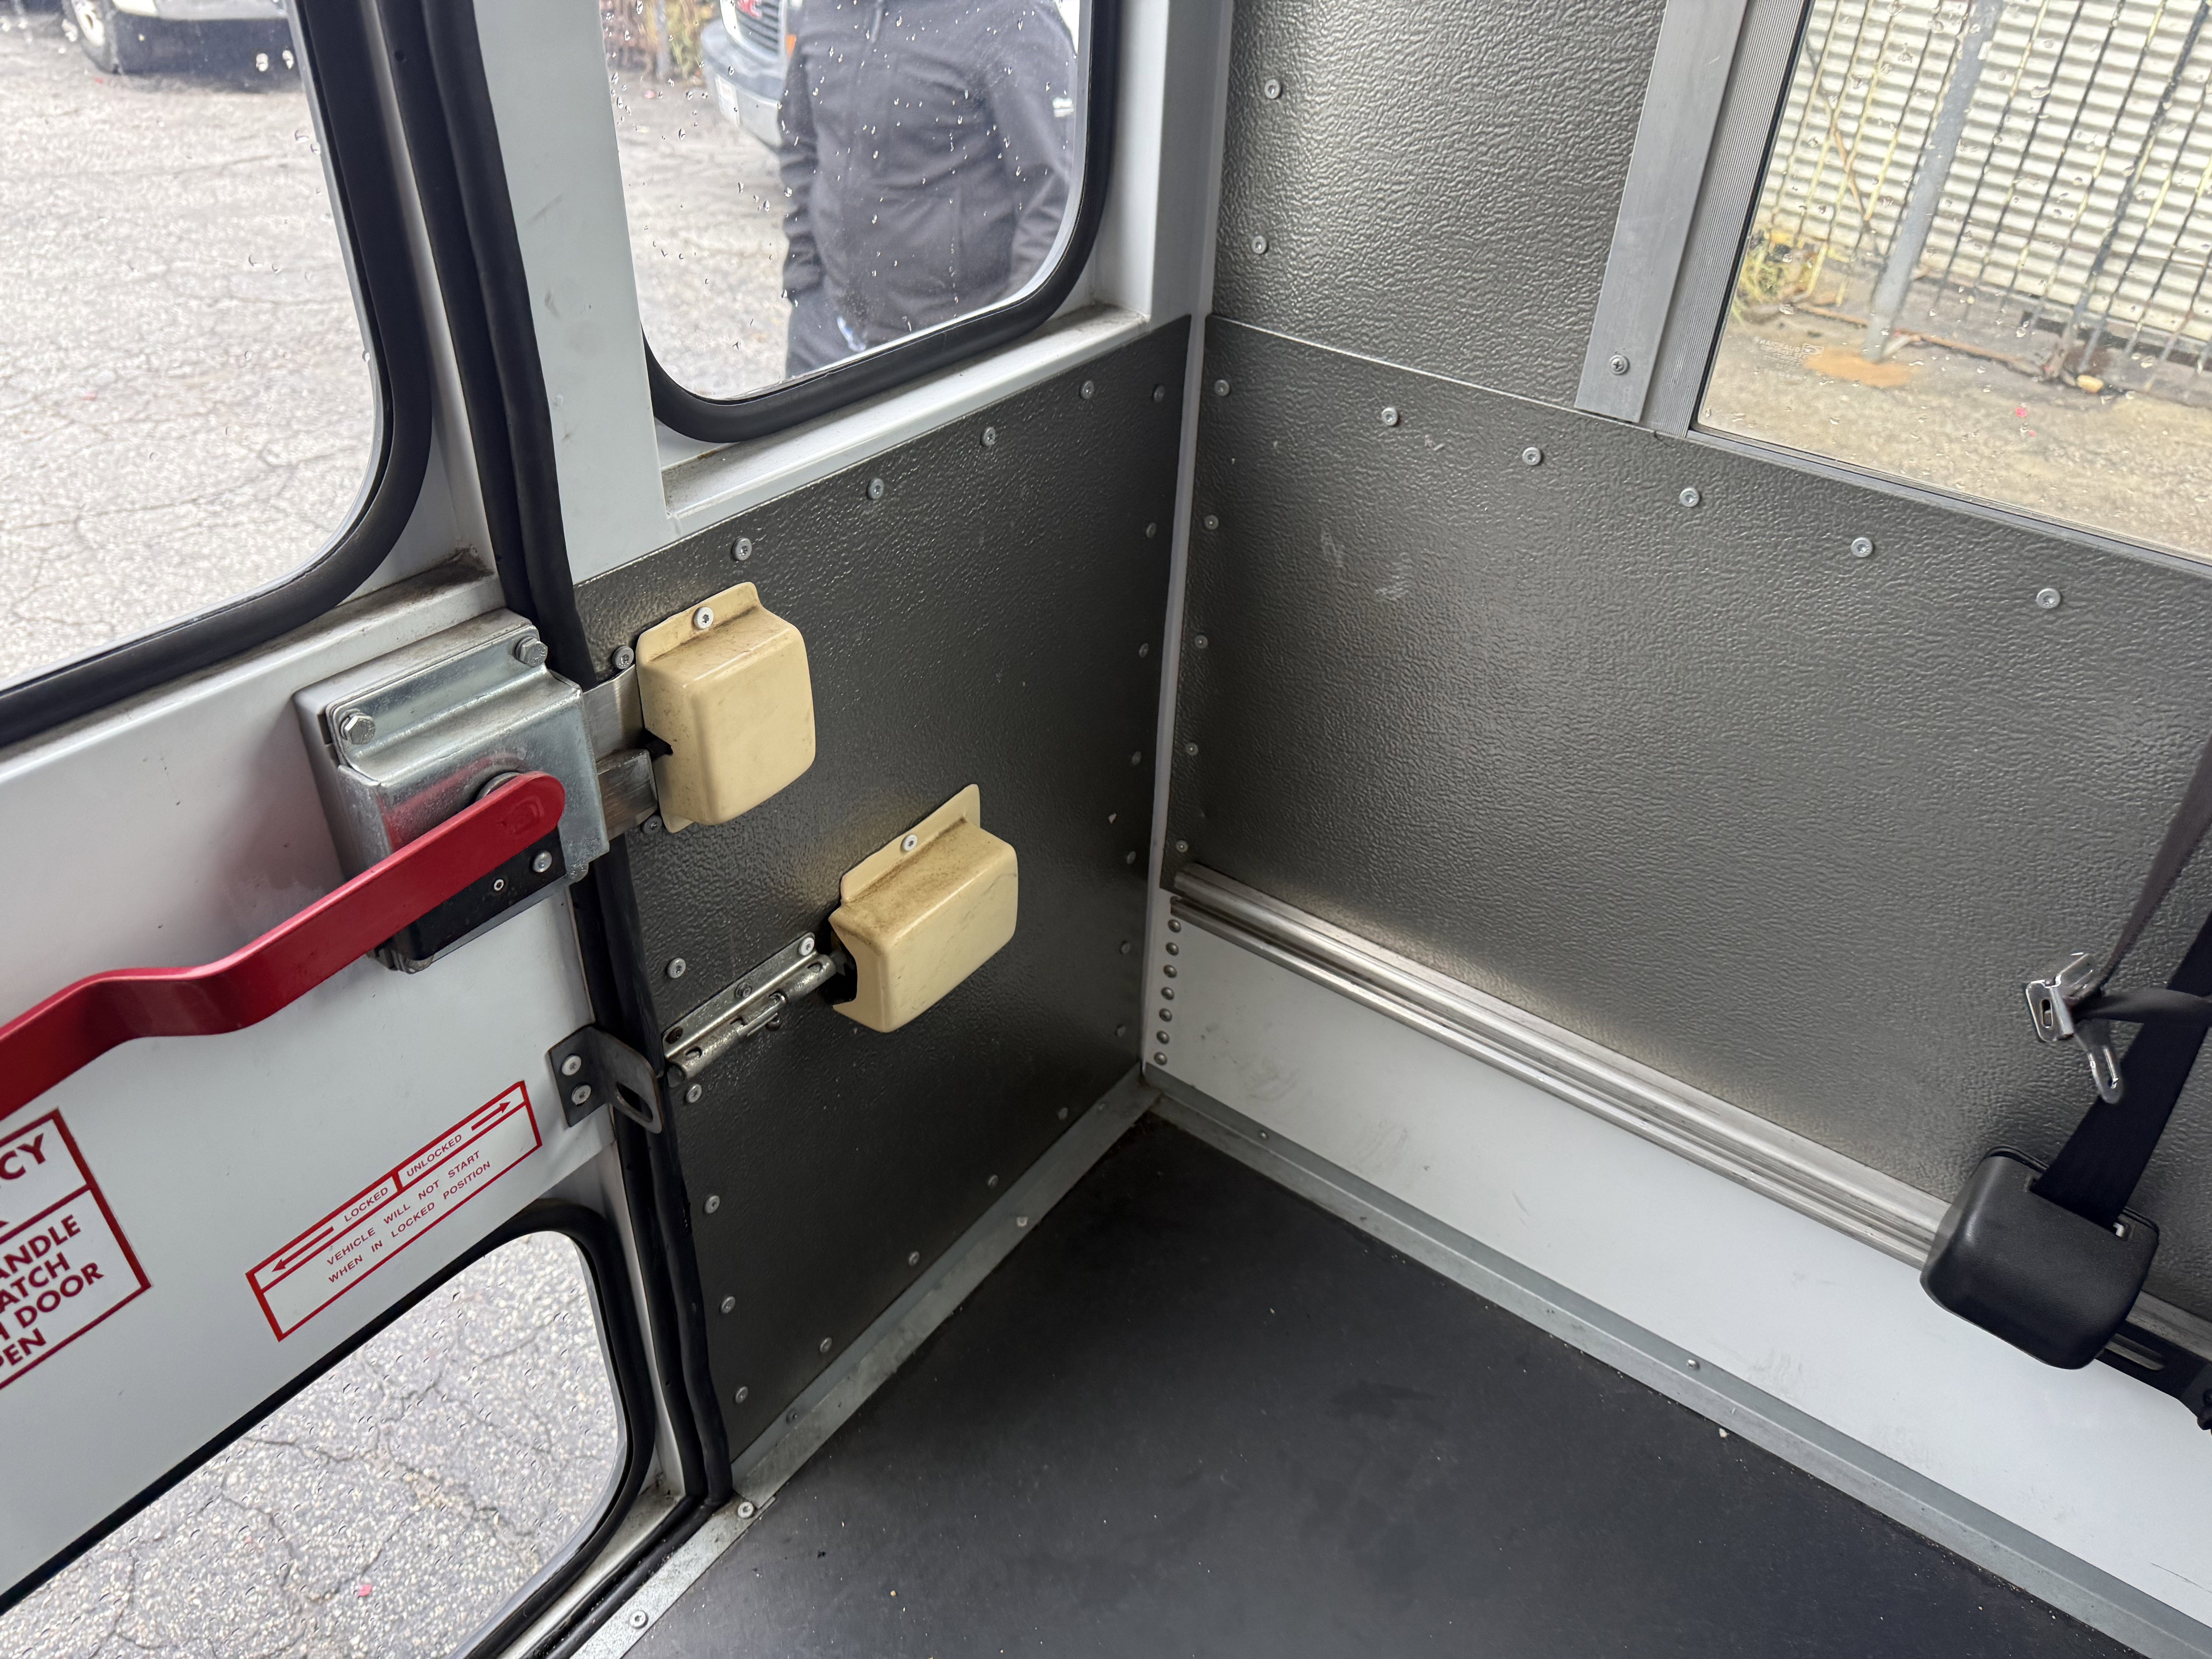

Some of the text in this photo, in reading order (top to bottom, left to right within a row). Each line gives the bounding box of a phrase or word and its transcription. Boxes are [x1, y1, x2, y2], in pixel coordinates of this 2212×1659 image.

[407, 1135, 462, 1177] UNLOCKED
[327, 1151, 479, 1265] VEHICLE WILL NOT START
[328, 1161, 490, 1283] WHEN IN LOCKED POSITION
[344, 1187, 388, 1222] LOCKED
[14, 1263, 104, 1329] DOOR
